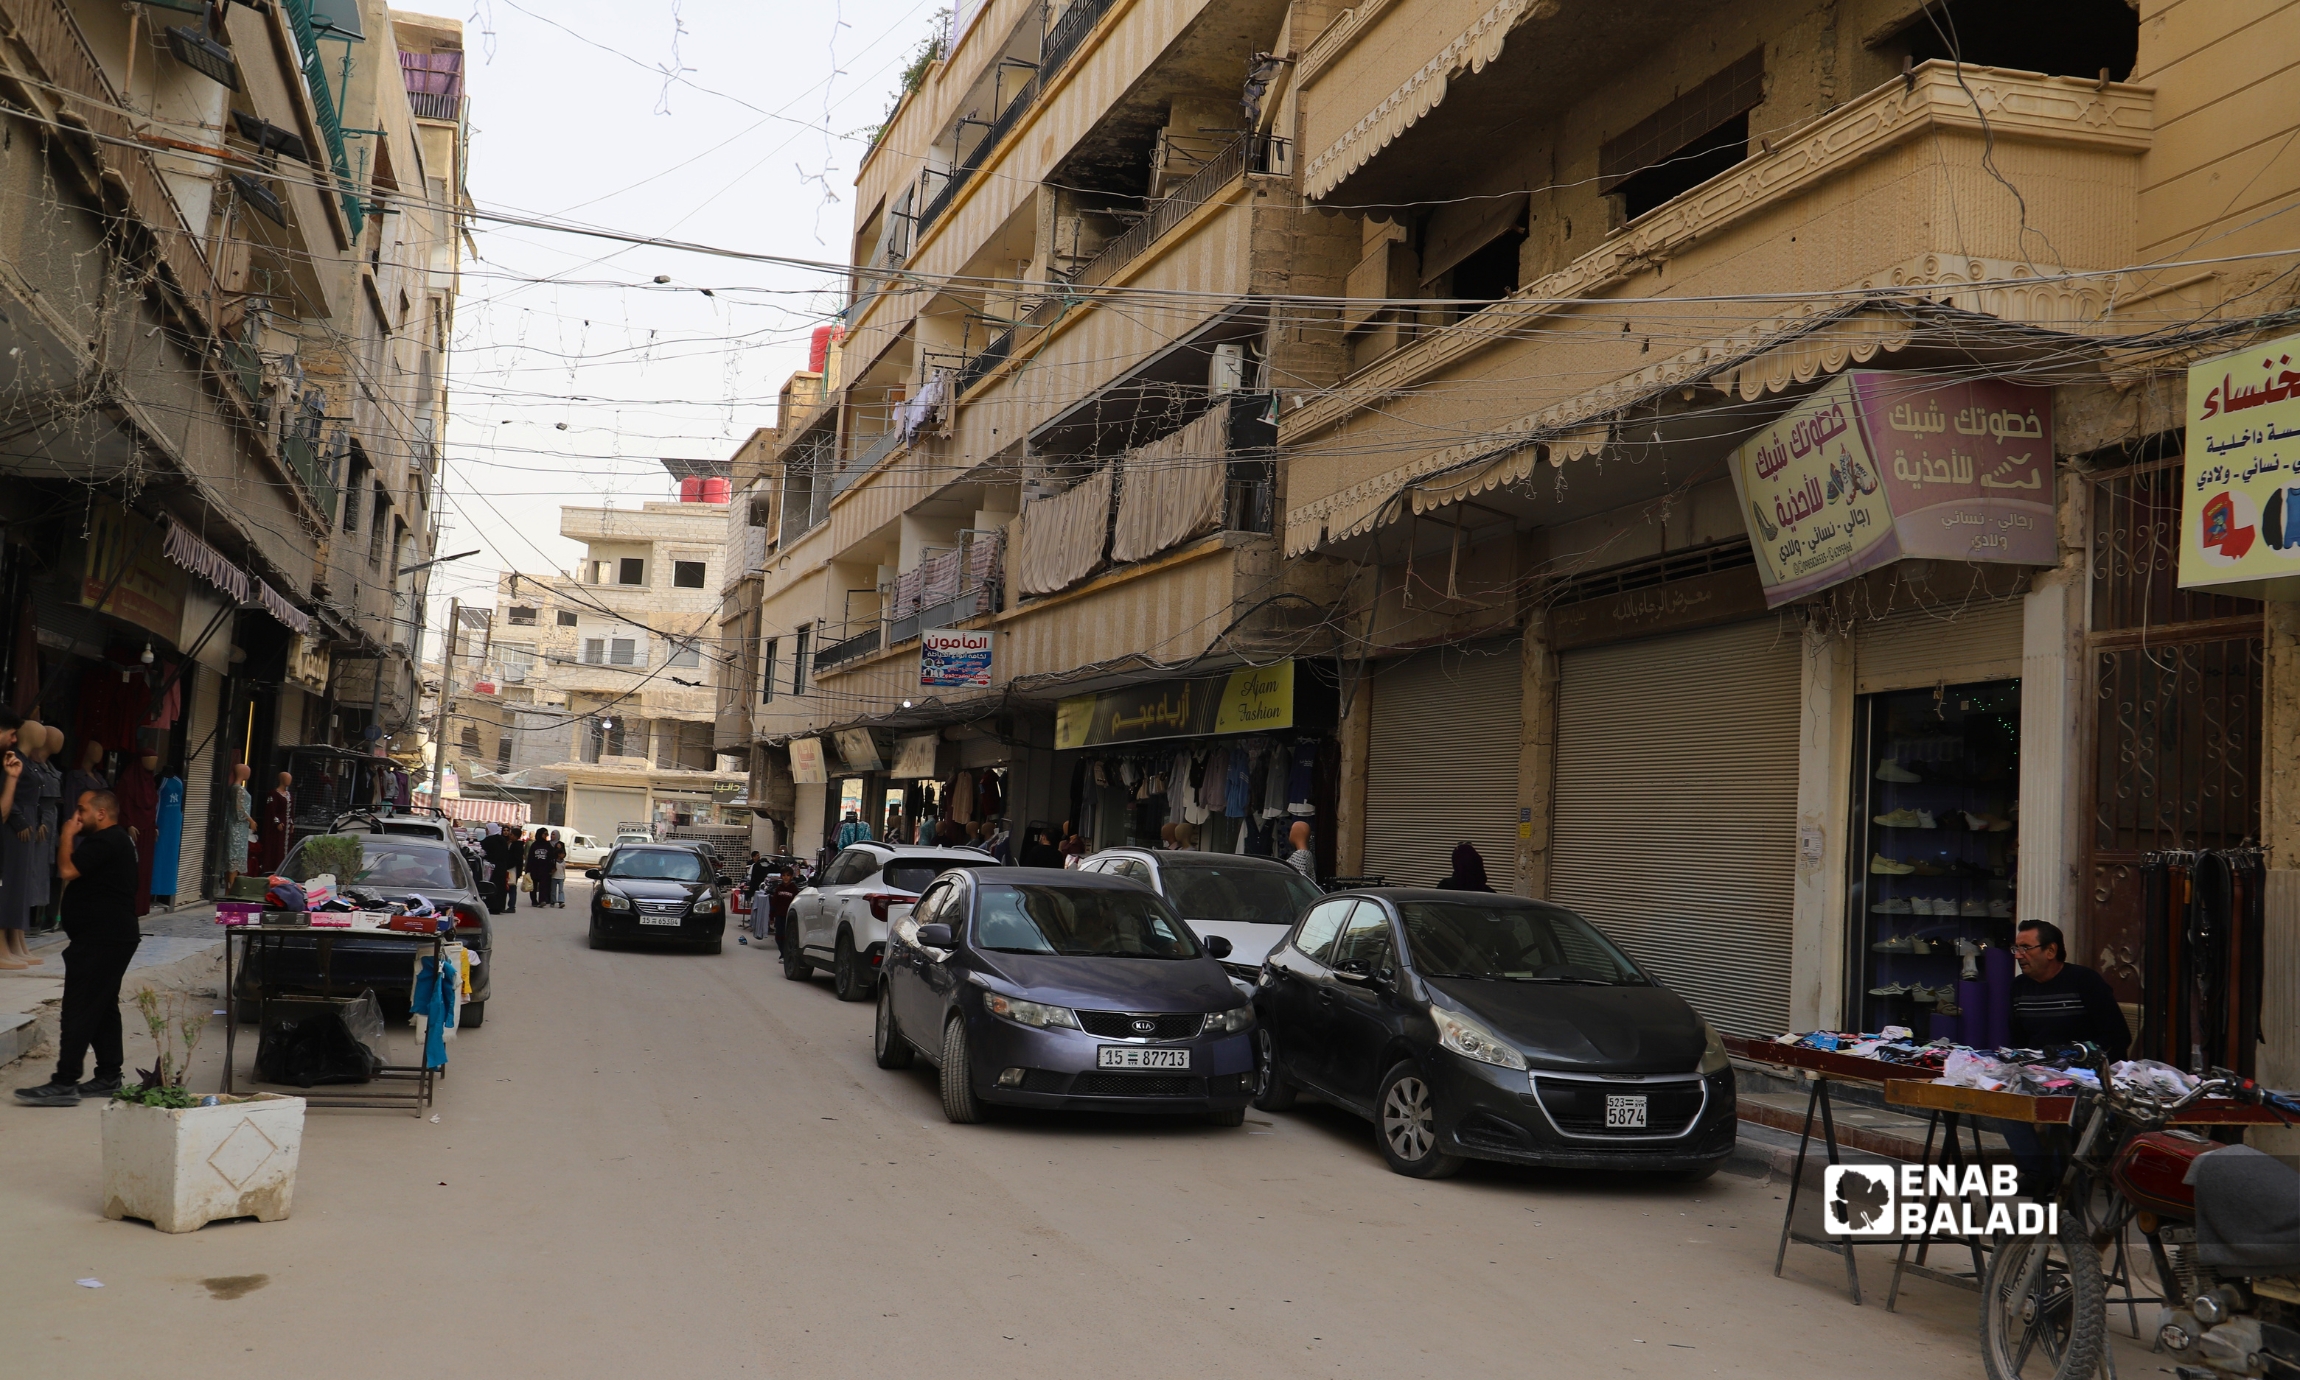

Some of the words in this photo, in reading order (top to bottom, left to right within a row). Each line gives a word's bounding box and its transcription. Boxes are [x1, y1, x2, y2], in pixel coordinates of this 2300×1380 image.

[1788, 397, 1848, 456] خطوتك
[1888, 398, 1946, 439] شيك
[1954, 406, 2043, 445] خطوتك
[2206, 427, 2263, 456] داخلية
[1755, 432, 1787, 483] شيك
[1893, 448, 1974, 490] للأحذية
[2242, 452, 2280, 483] نسائي
[2196, 464, 2230, 491] ولادي
[1775, 475, 1825, 532] للأحذية
[1843, 507, 1871, 541] رجالي
[1941, 509, 1985, 530] نسائي
[1996, 511, 2034, 532] رجالي
[1778, 537, 1802, 566] ولادي
[1807, 522, 1836, 554] نسائي
[1971, 532, 2009, 550] ولادي
[1668, 588, 1712, 614] معرض
[927, 650, 950, 659] الخياطة
[928, 633, 987, 650] المأمون
[951, 651, 968, 660] أنواع
[1240, 673, 1280, 703] Ajam
[1111, 703, 1156, 735] عجم
[1156, 681, 1191, 729] أزياء
[1238, 701, 1282, 722] Fashion
[714, 782, 741, 793] داليا
[1135, 1022, 1151, 1030] KIA
[1105, 1049, 1122, 1065] 15
[1143, 1050, 1185, 1067] 87713
[1609, 1097, 1624, 1107] 523
[1609, 1108, 1645, 1125] 5874
